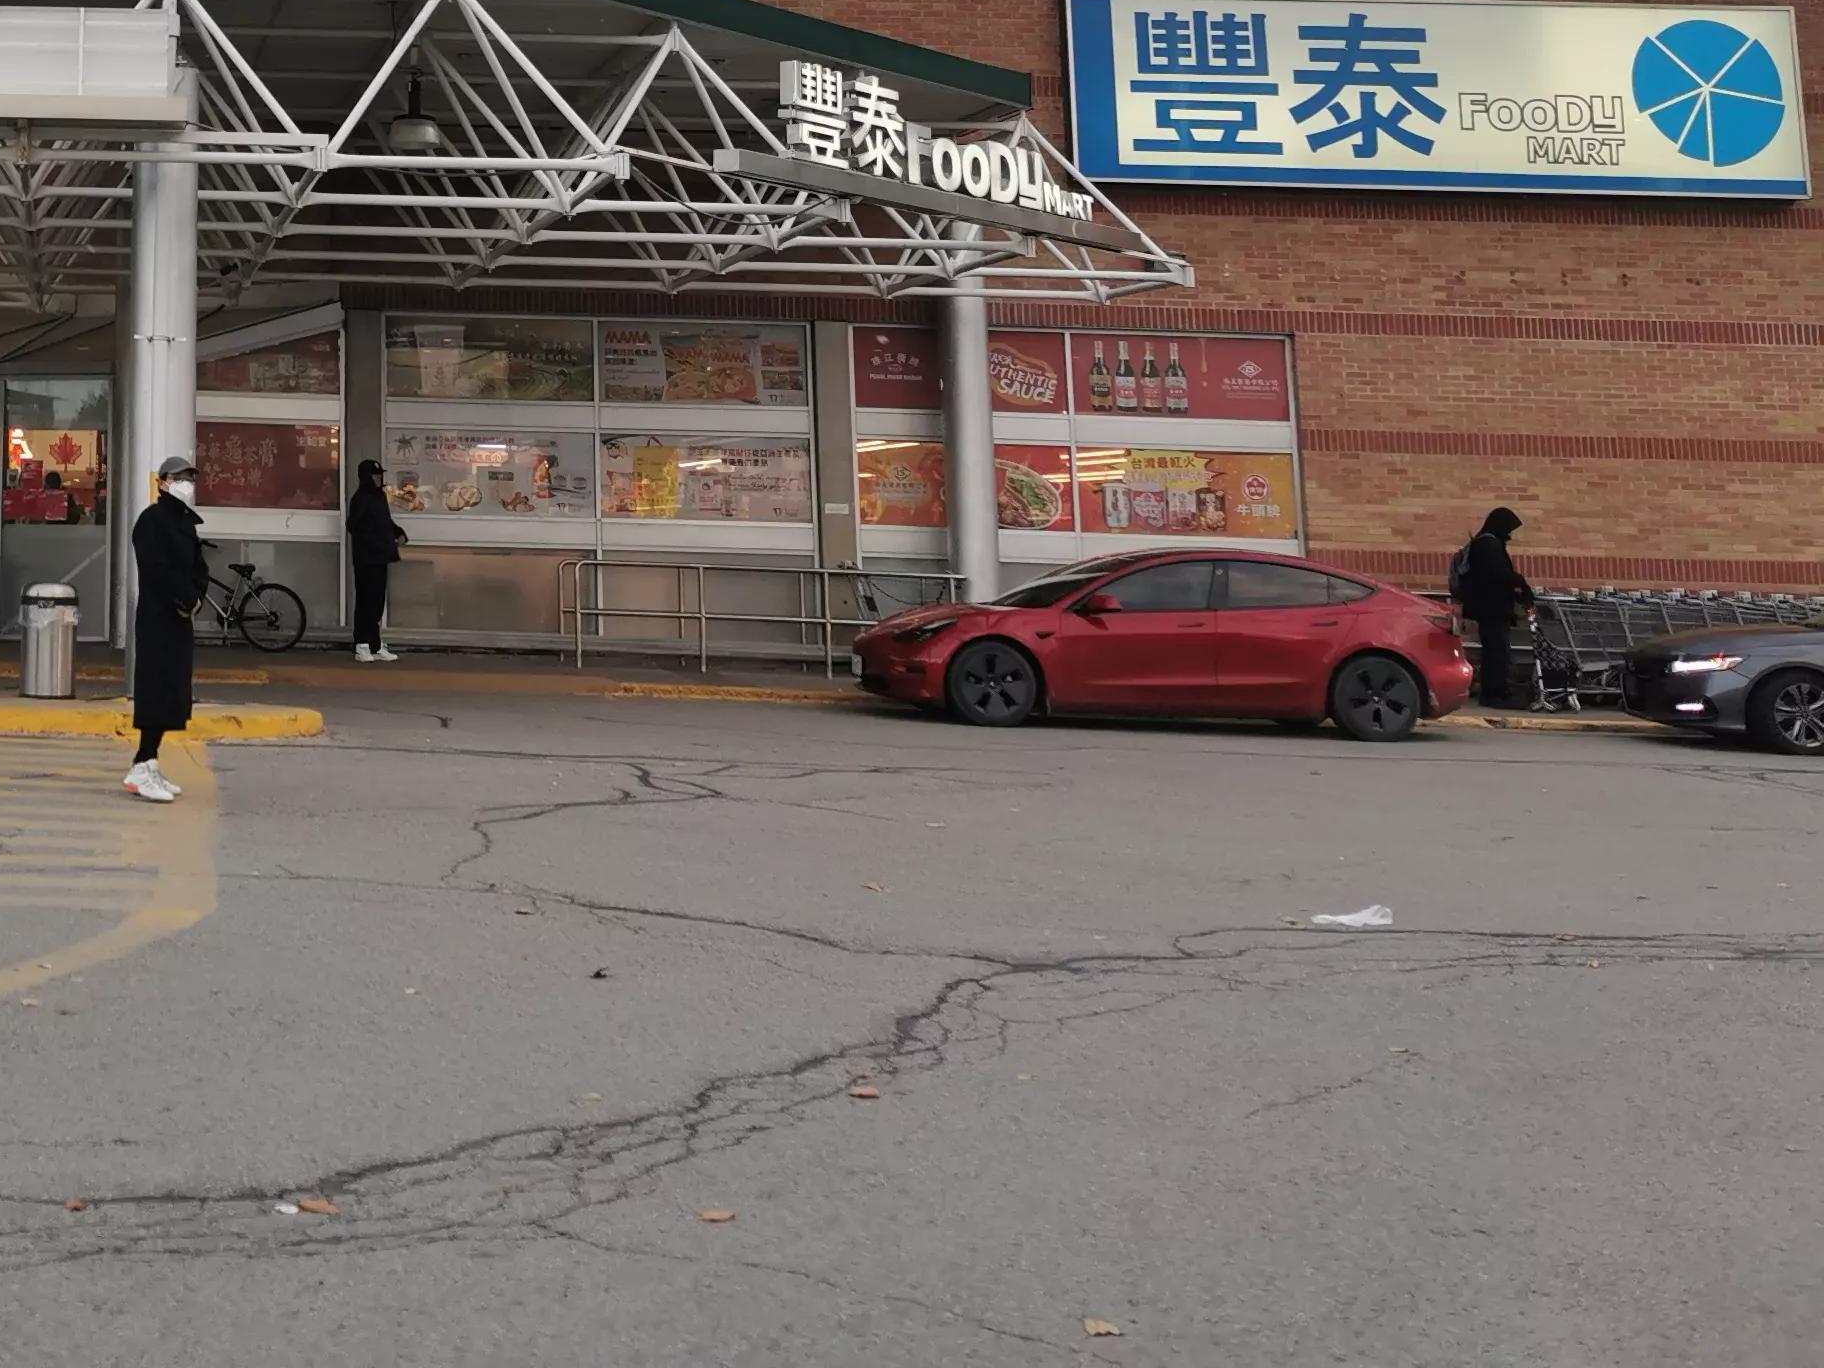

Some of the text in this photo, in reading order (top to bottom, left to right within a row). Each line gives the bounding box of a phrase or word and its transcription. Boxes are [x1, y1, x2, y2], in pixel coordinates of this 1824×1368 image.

[1129, 10, 1448, 159] 豐泰
[778, 60, 907, 179] 豐泰
[1041, 181, 1095, 222] MART
[1526, 136, 1626, 166] MART
[989, 363, 1058, 390] UTHENTIC
[997, 378, 1056, 404] SAUCE
